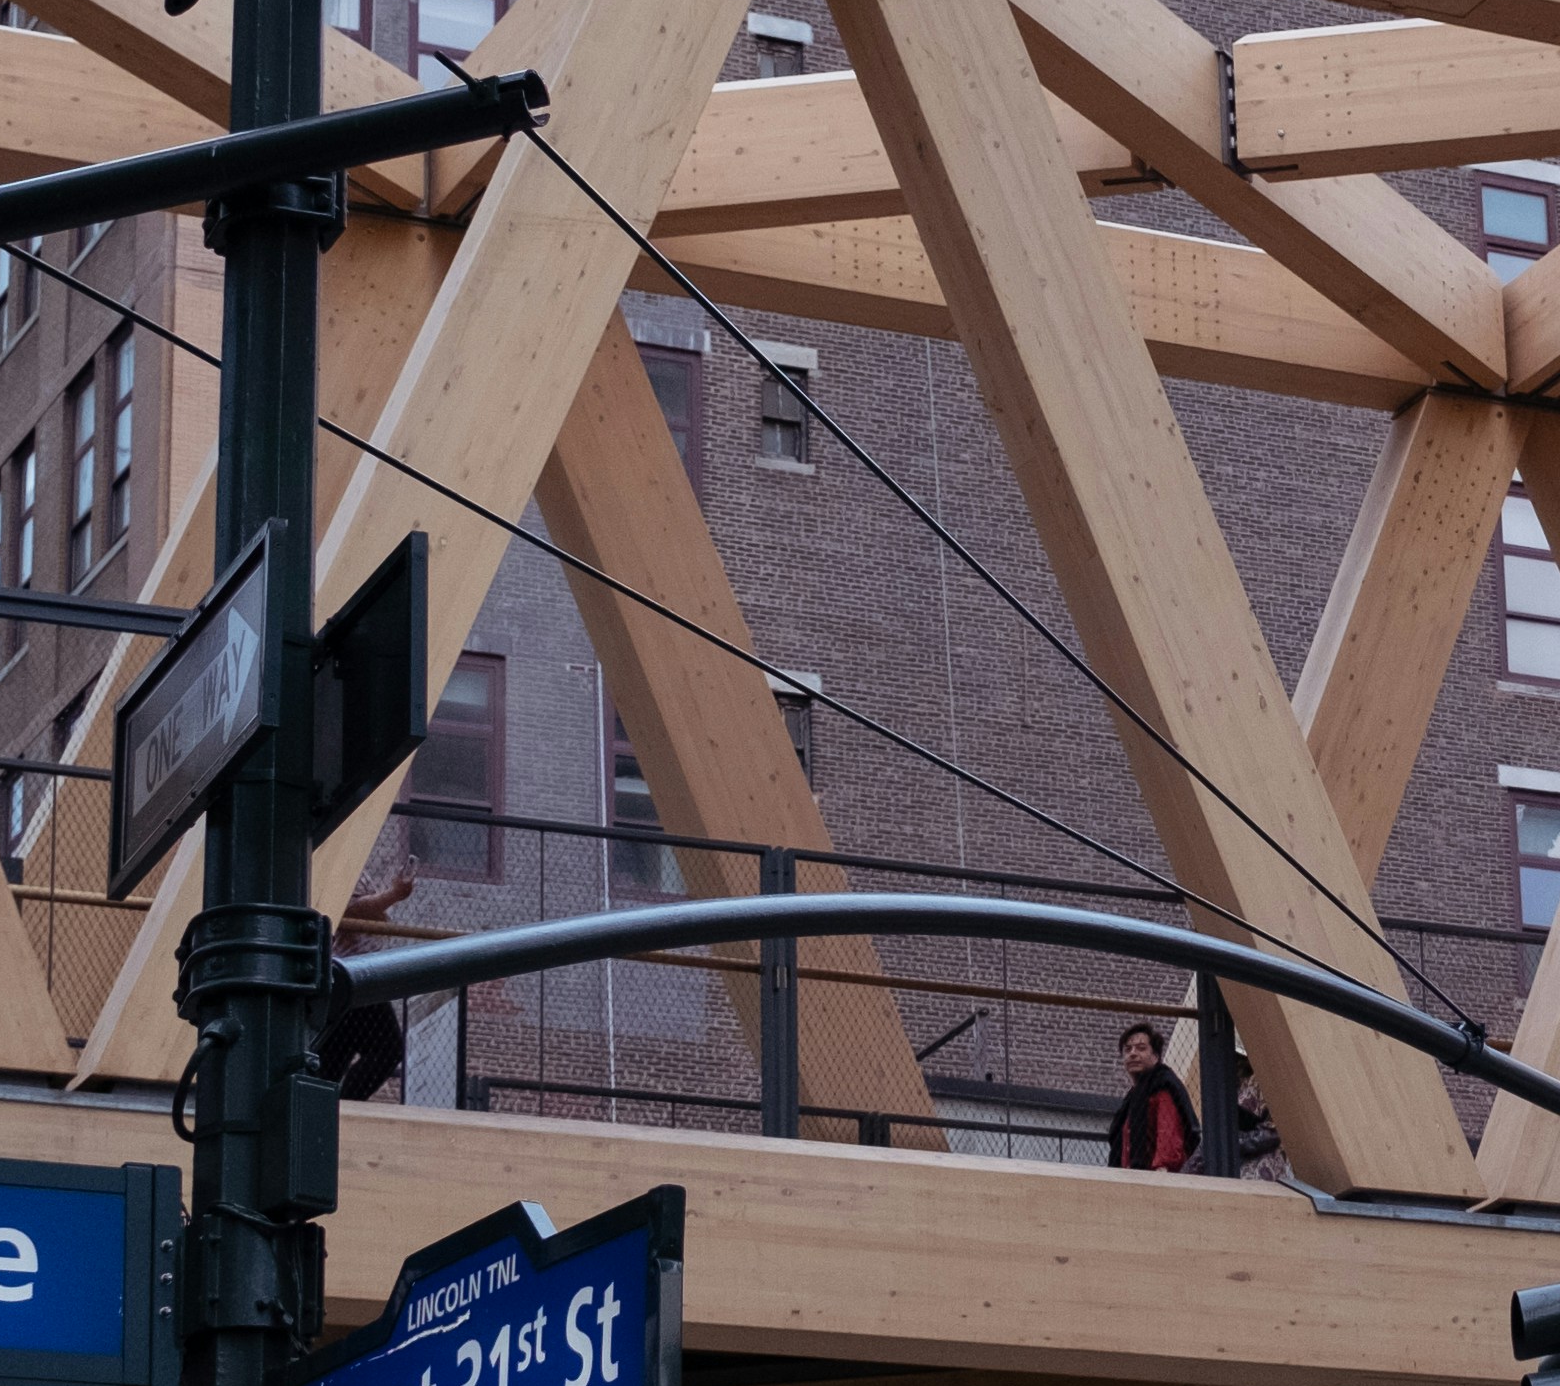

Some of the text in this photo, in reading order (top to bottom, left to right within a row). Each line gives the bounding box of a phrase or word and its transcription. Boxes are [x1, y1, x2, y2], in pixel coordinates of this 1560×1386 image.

[146, 629, 246, 794] ONE WAY
[406, 1252, 521, 1332] LINCOLN TNL
